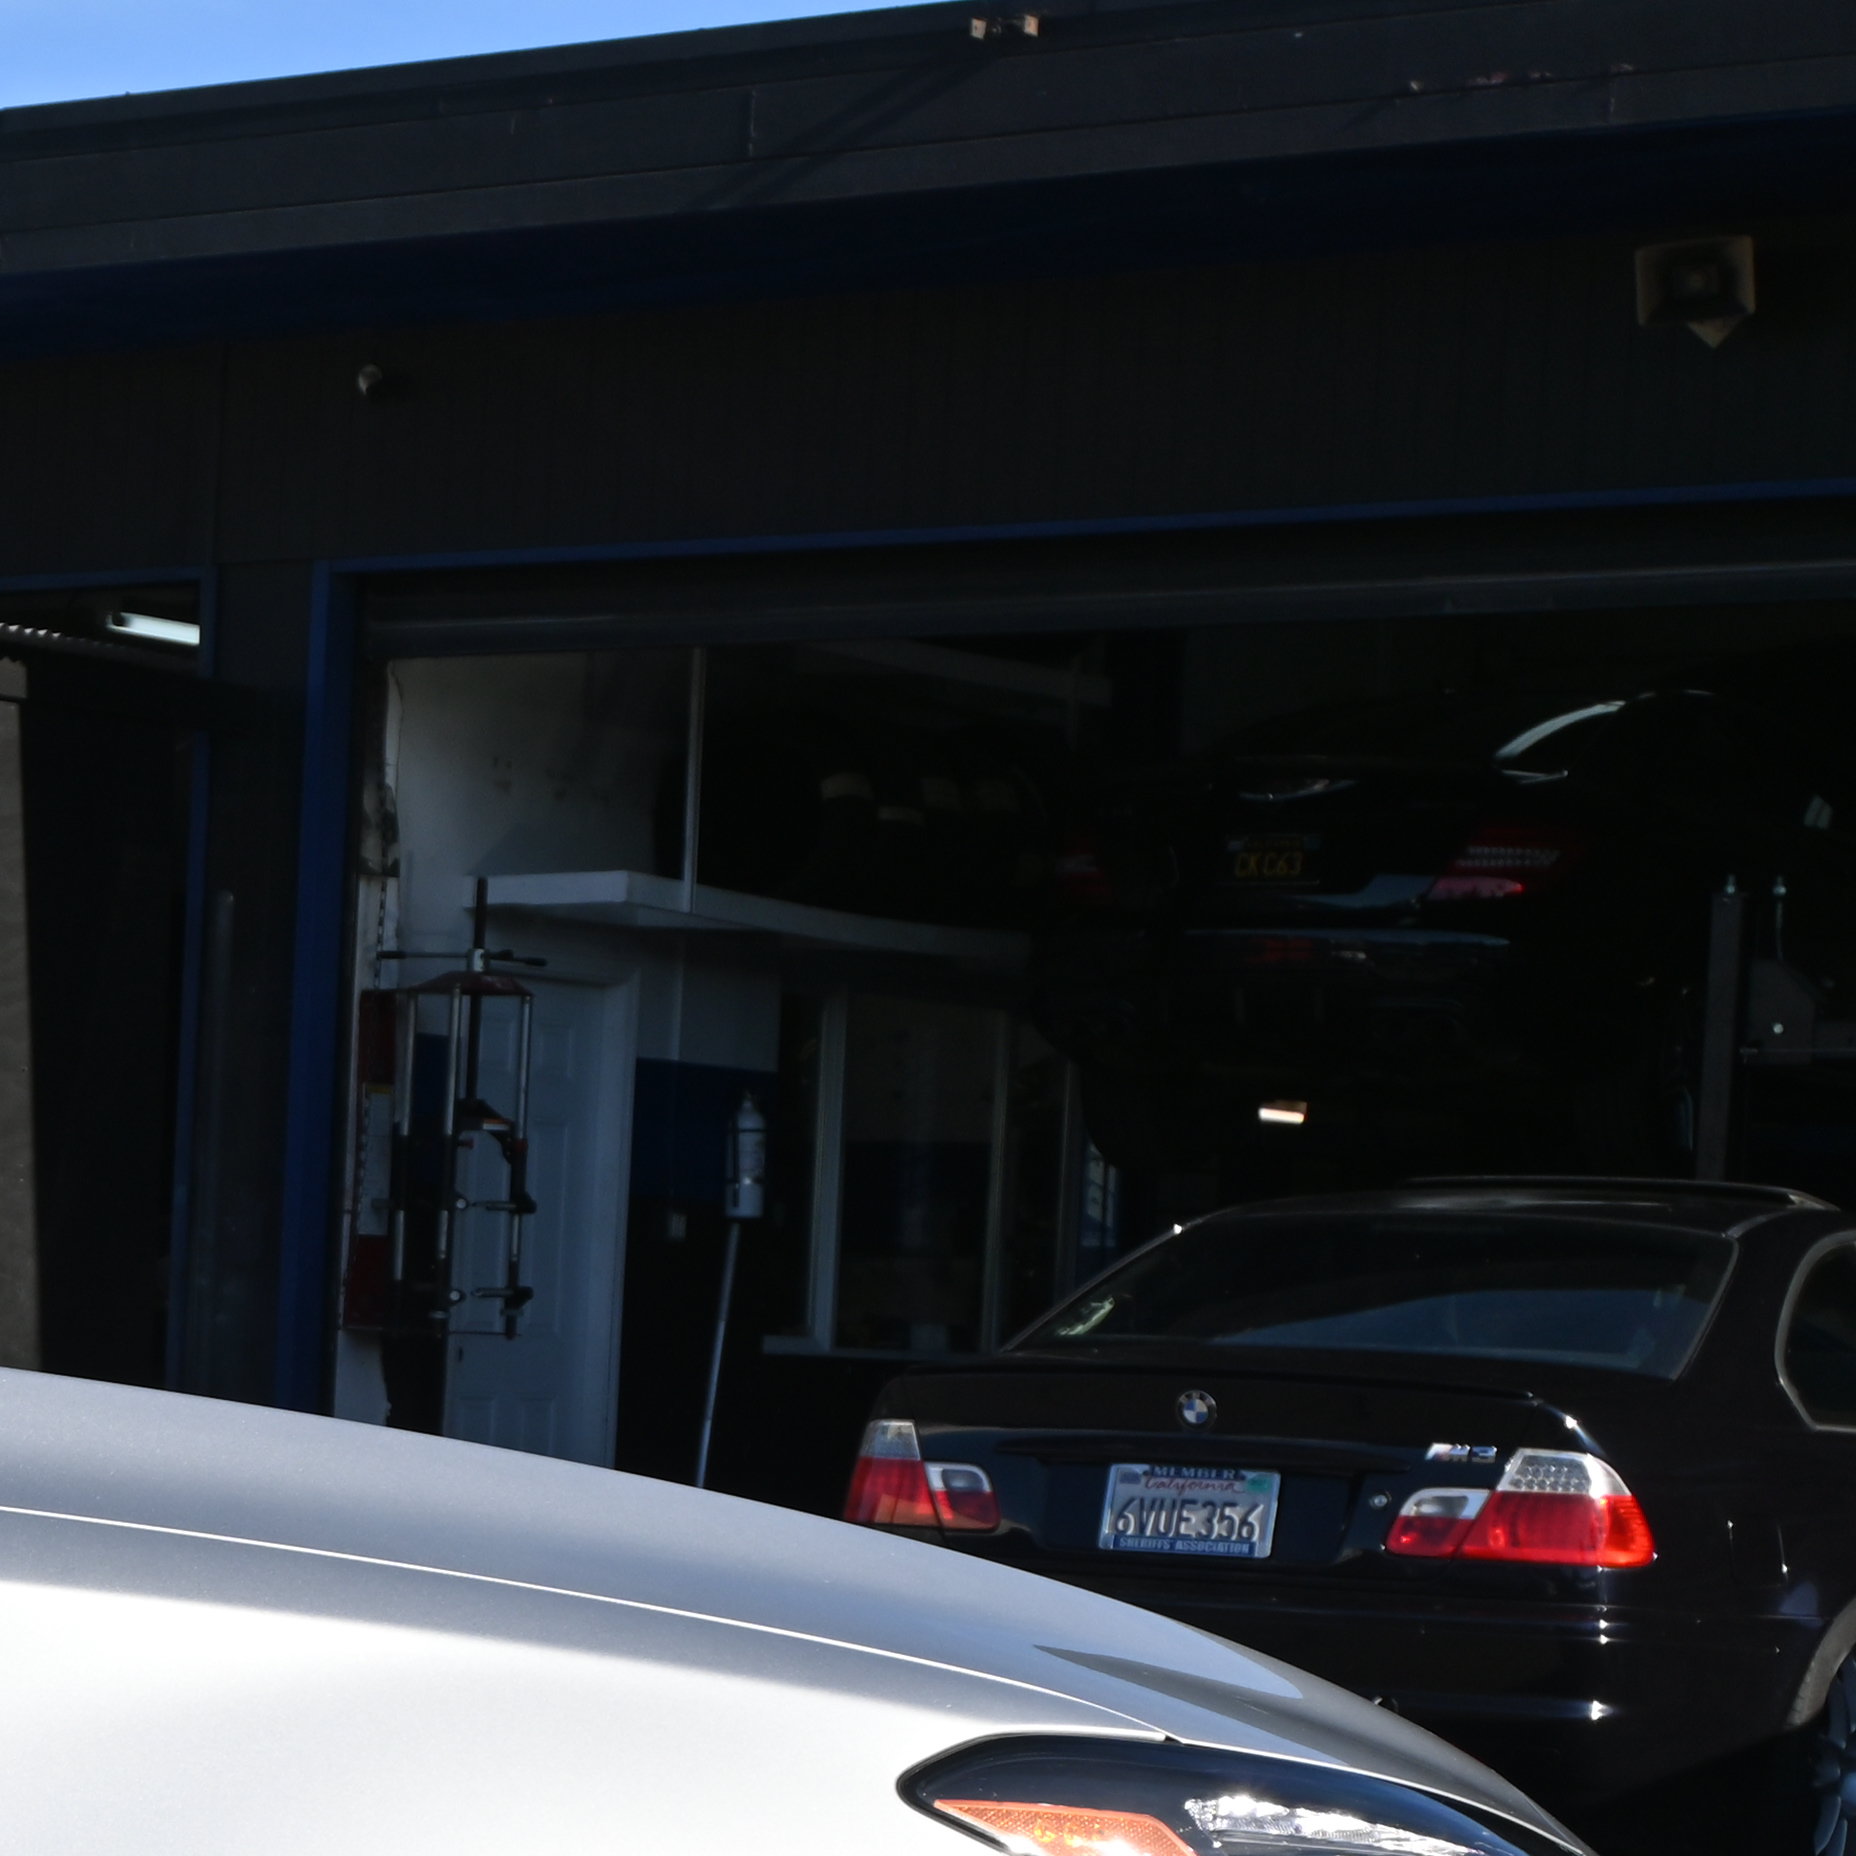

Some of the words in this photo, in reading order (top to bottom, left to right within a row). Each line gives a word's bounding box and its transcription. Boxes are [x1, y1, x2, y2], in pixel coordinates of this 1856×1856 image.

[1154, 1465, 1236, 1480] MEMBER
[1144, 1475, 1245, 1496] California
[1116, 1497, 1264, 1542] 6VUE356
